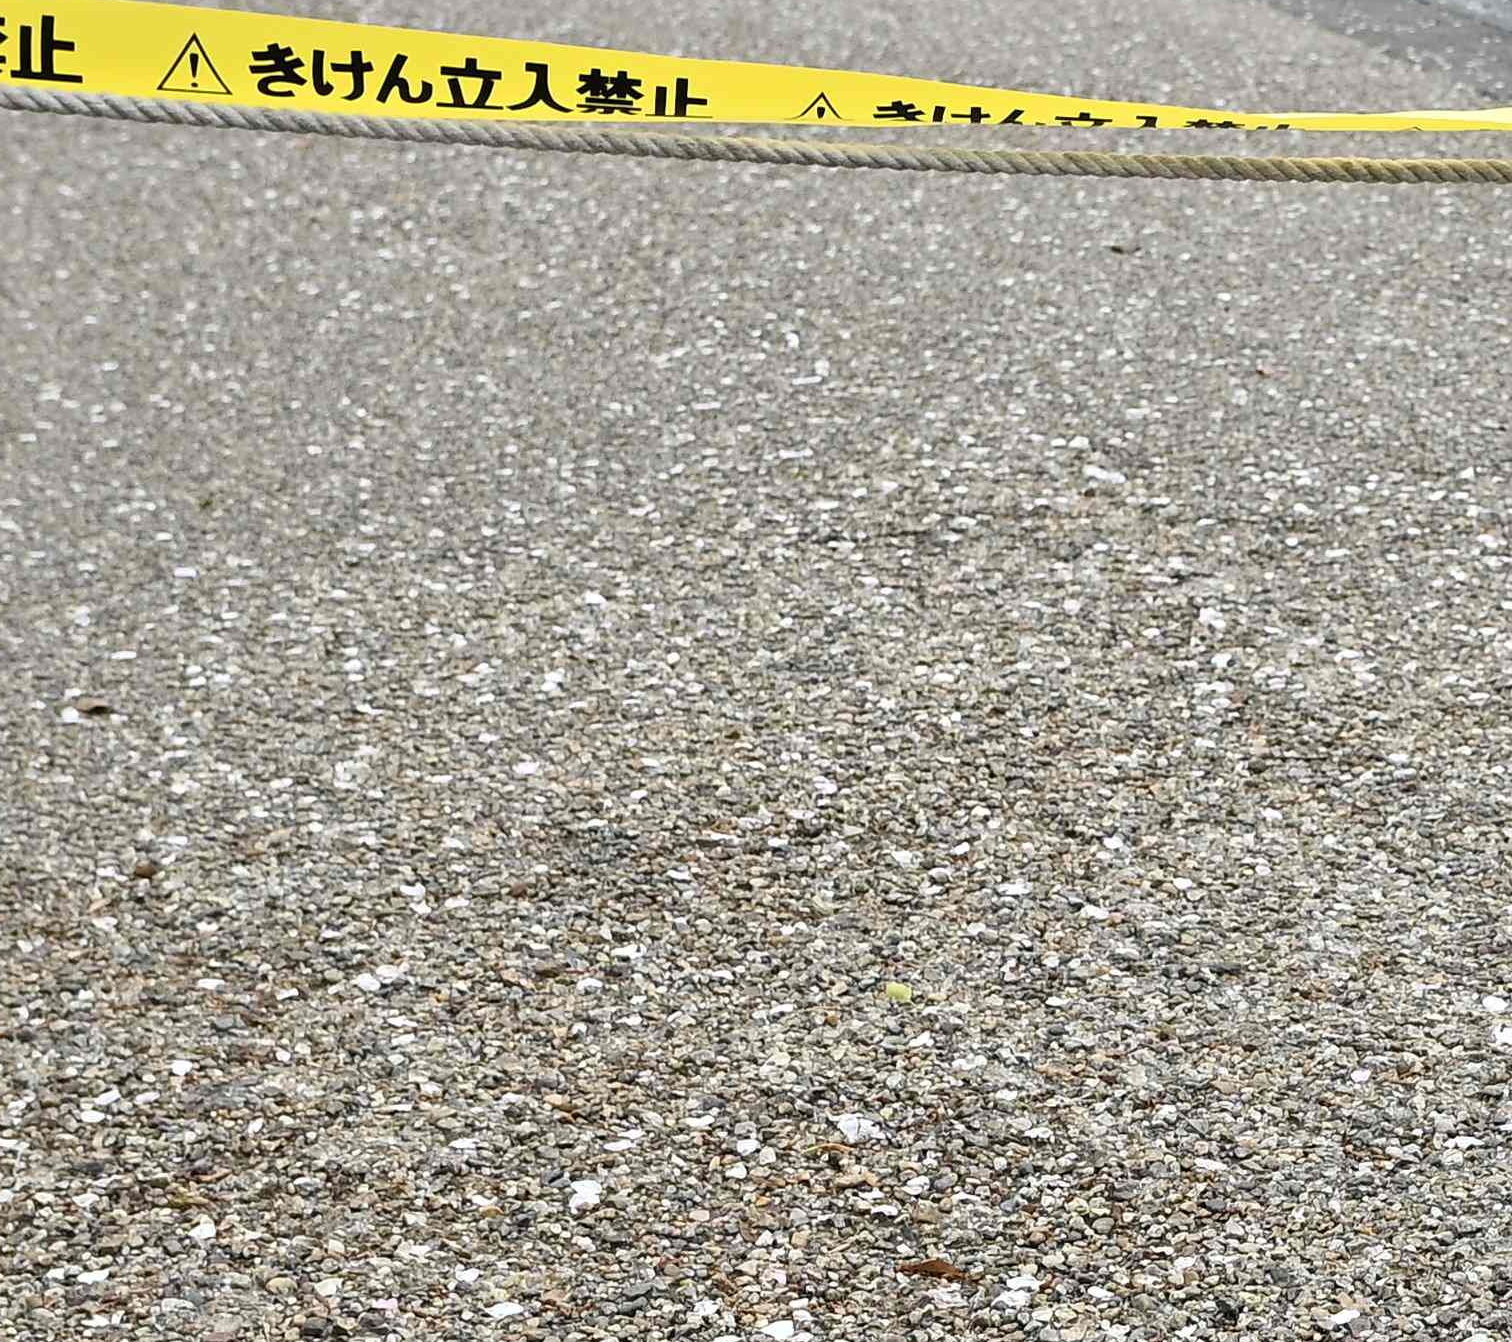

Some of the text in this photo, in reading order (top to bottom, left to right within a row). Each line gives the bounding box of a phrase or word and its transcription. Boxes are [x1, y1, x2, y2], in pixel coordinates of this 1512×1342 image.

[248, 42, 714, 120] きけん立入禁止
